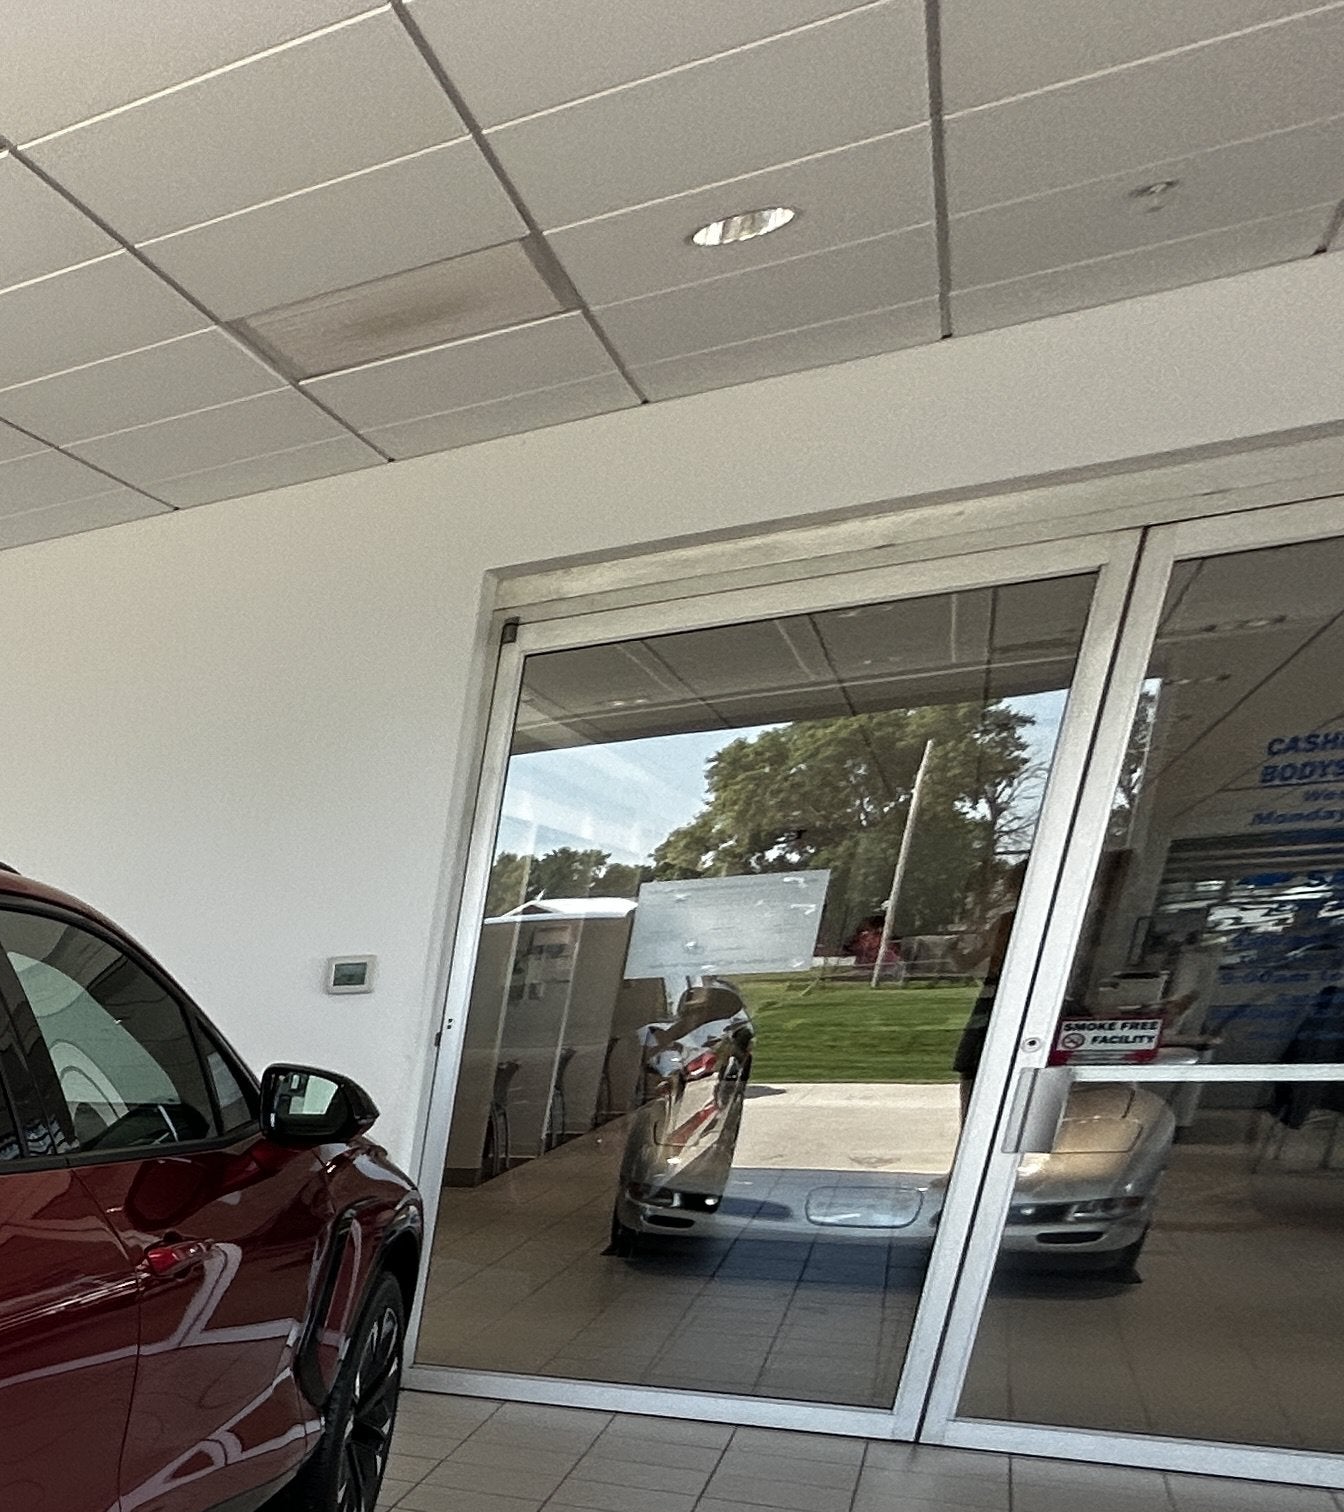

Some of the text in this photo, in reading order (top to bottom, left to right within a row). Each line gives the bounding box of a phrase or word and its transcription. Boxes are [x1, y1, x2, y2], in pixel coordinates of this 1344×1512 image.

[1063, 1020, 1159, 1032] SMOKE FREE
[1090, 1035, 1156, 1045] FACILITY
